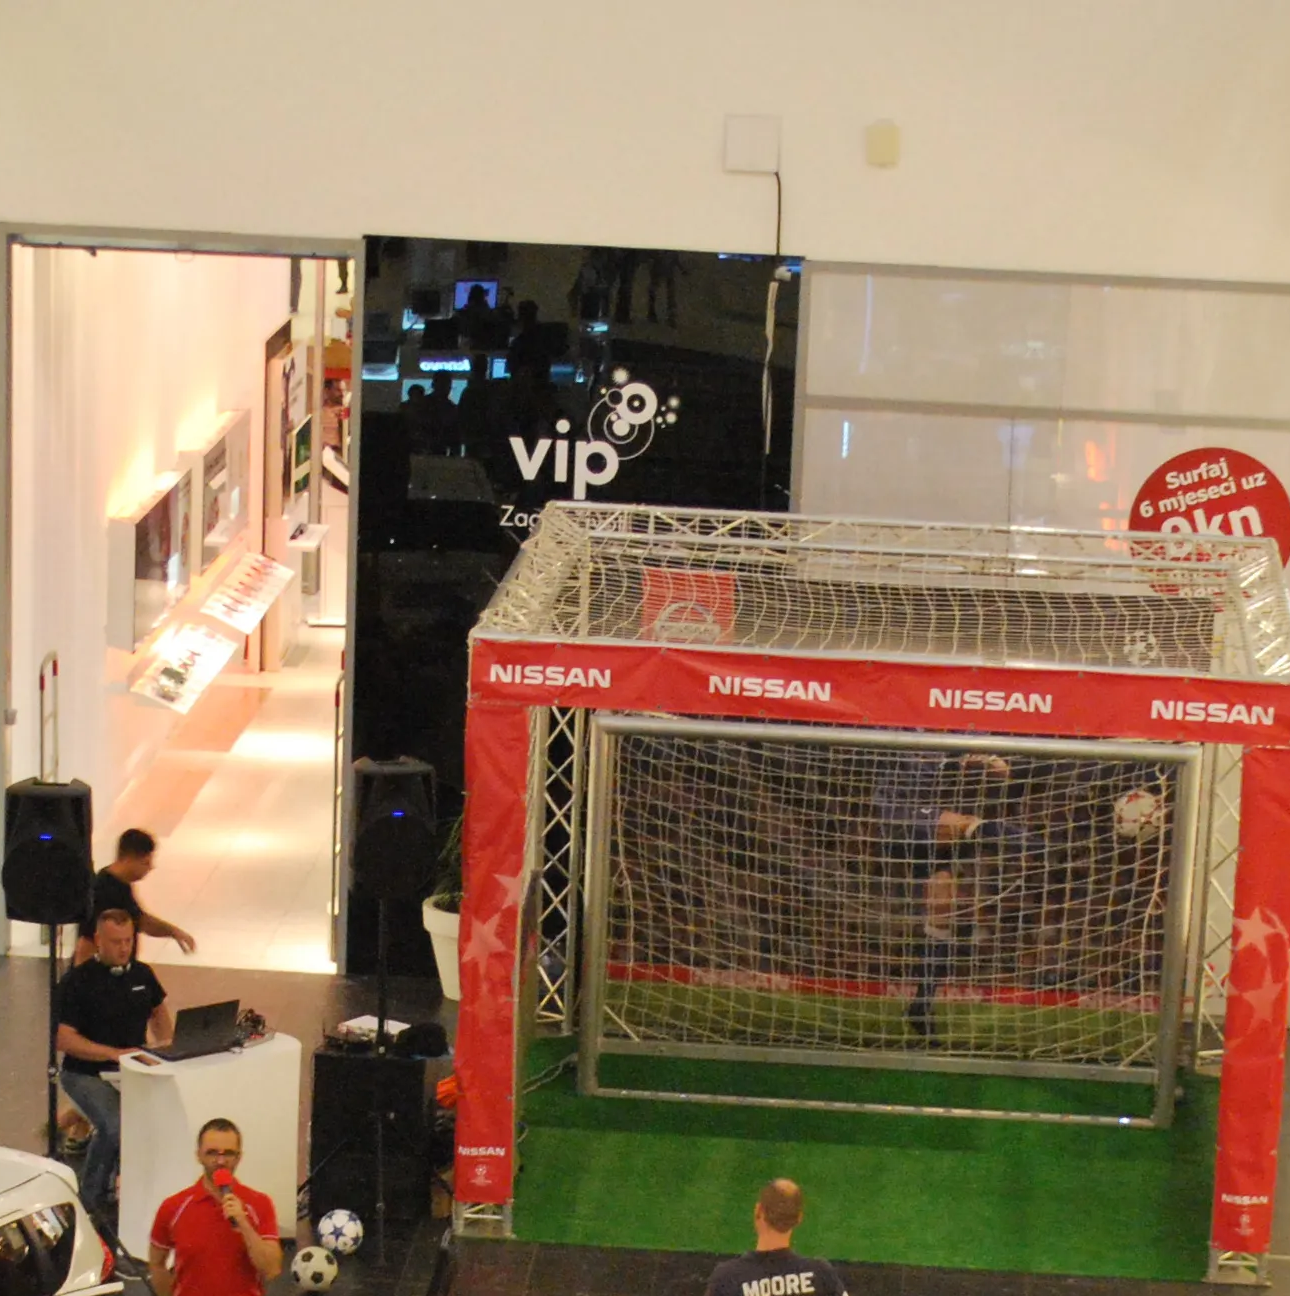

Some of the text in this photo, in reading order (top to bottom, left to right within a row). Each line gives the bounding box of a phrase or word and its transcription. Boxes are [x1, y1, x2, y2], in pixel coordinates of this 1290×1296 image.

[508, 419, 620, 500] vip
[1165, 457, 1229, 490] Surfaj
[1139, 471, 1268, 518] 6 mjeseci uz
[489, 663, 612, 689] NISSAN
[708, 675, 832, 702] NISSAN
[928, 687, 1054, 714] NISSAN
[1150, 699, 1275, 726] NISSAN
[458, 1145, 506, 1157] NISSAN
[1221, 1193, 1269, 1205] NISSAN
